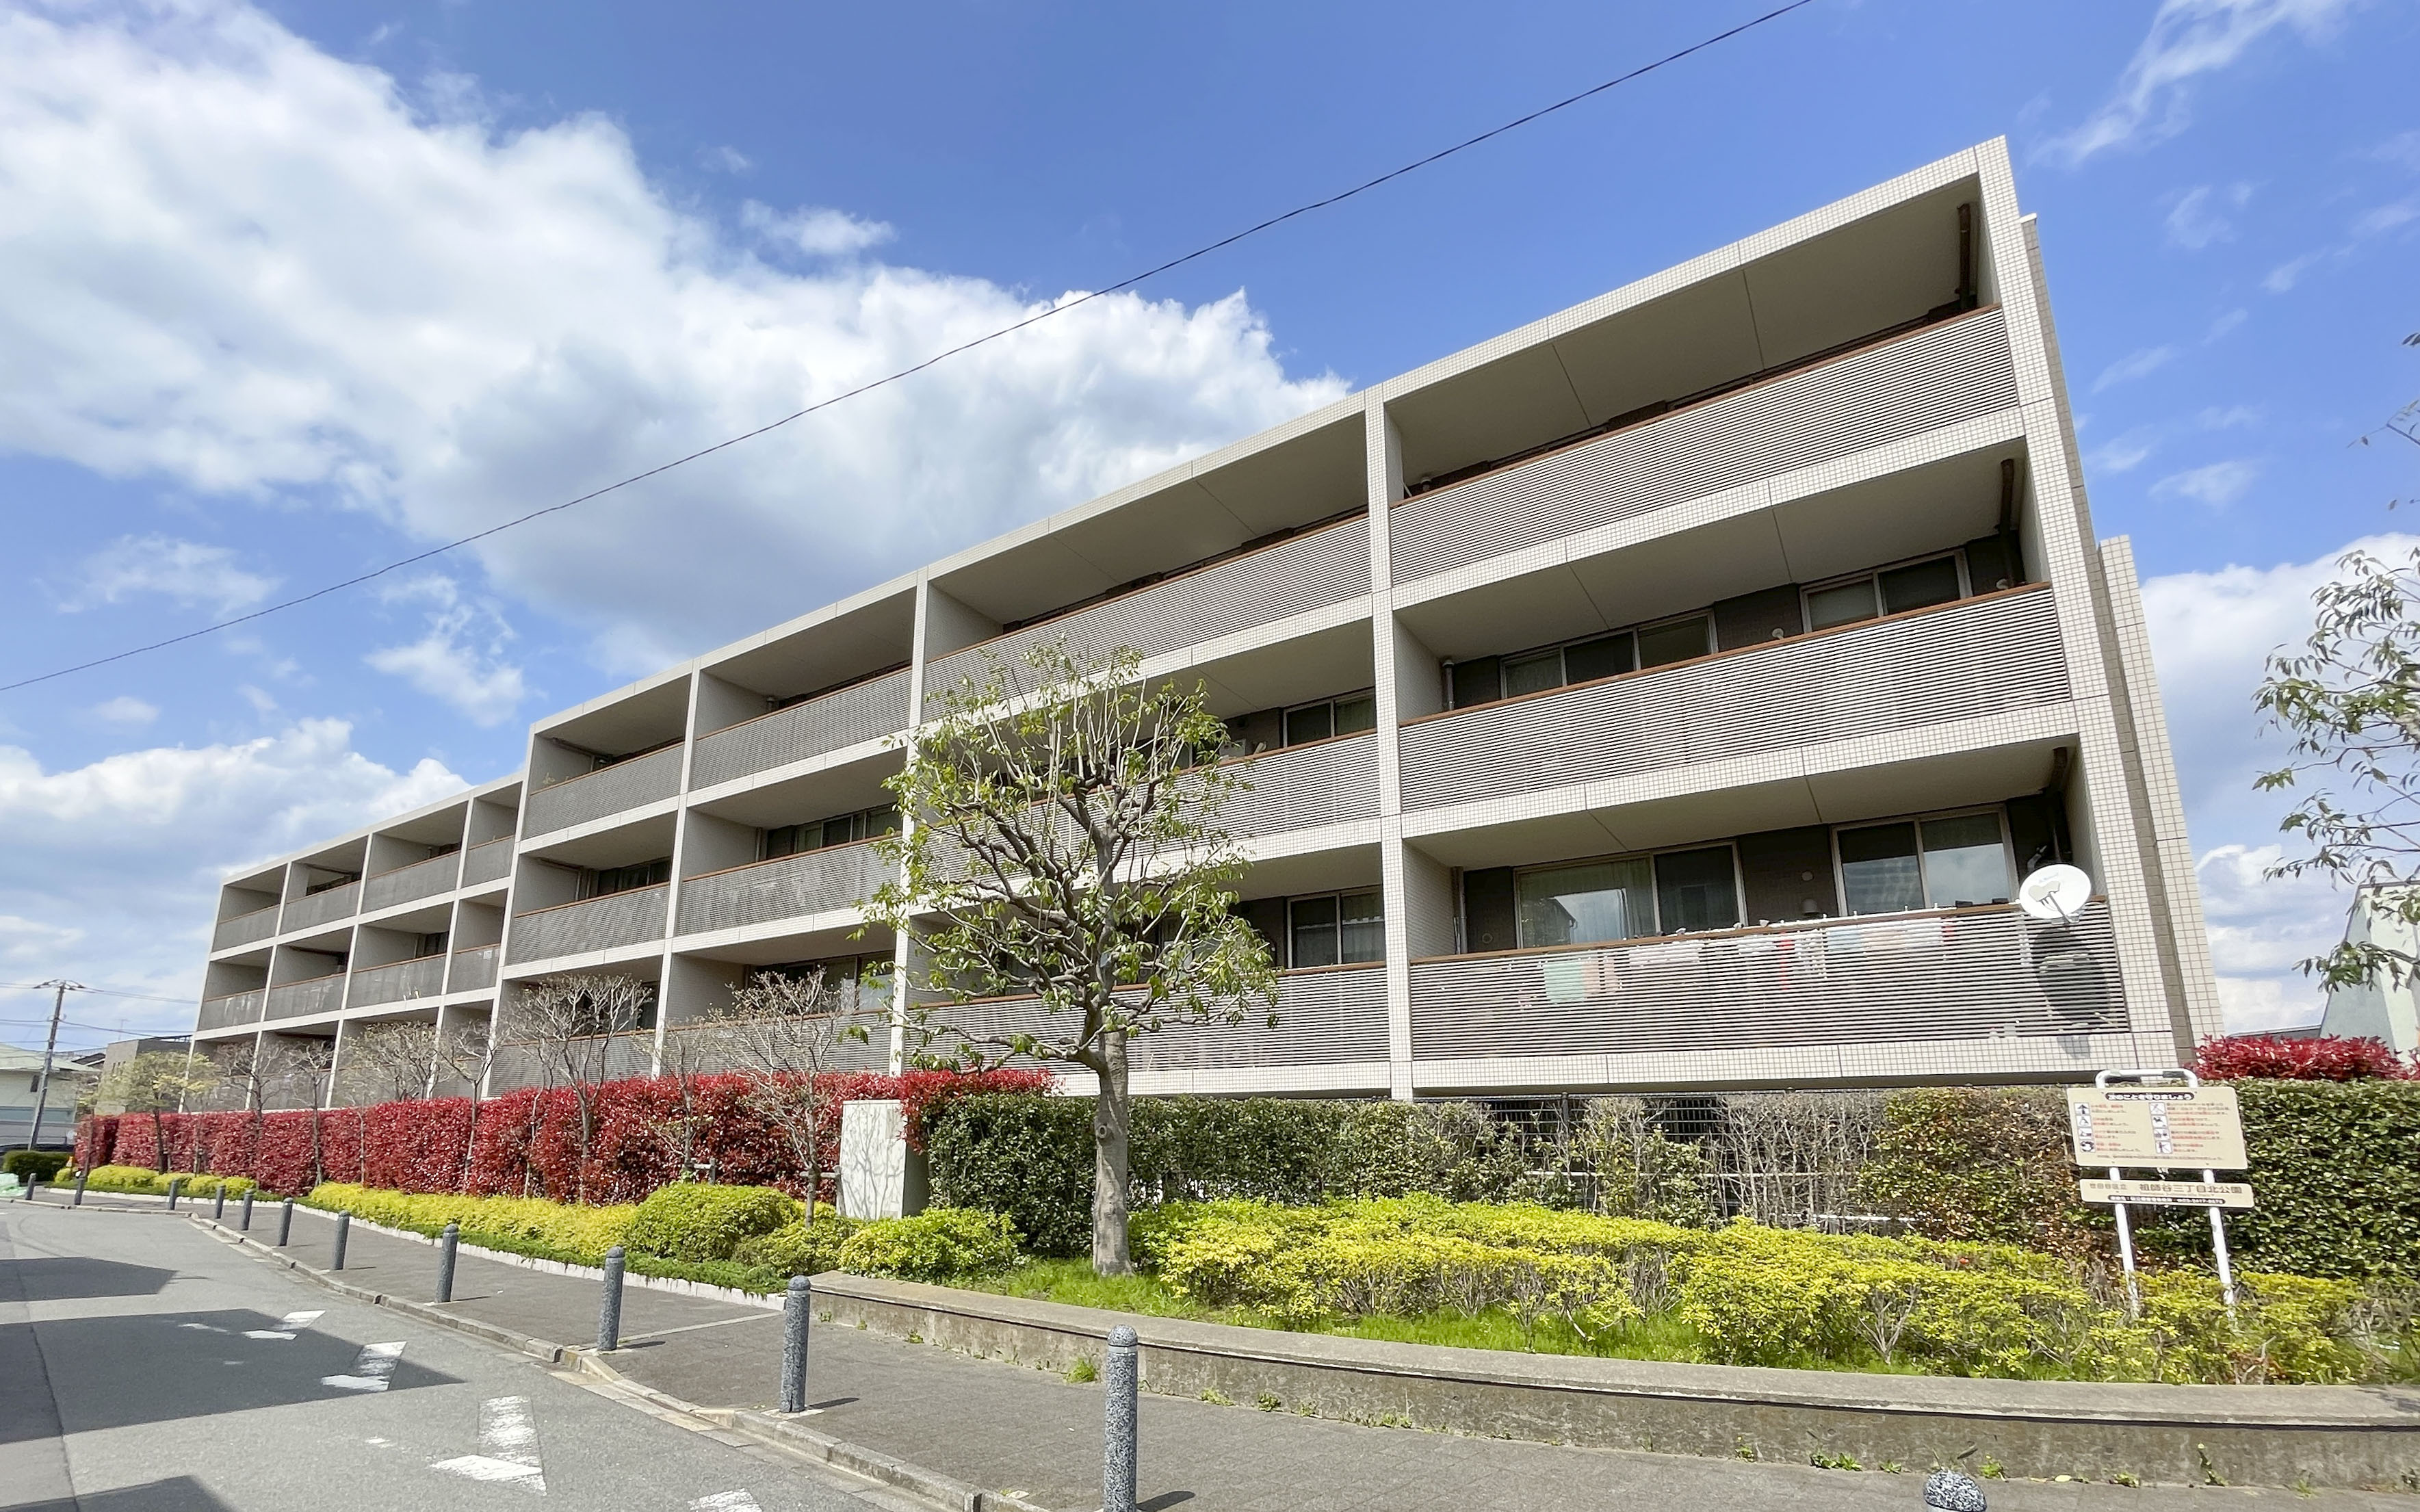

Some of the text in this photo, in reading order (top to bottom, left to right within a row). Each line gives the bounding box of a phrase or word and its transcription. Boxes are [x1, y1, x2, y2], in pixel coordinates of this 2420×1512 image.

[2139, 1184, 2242, 1194] 祖師谷三丁目北公園
